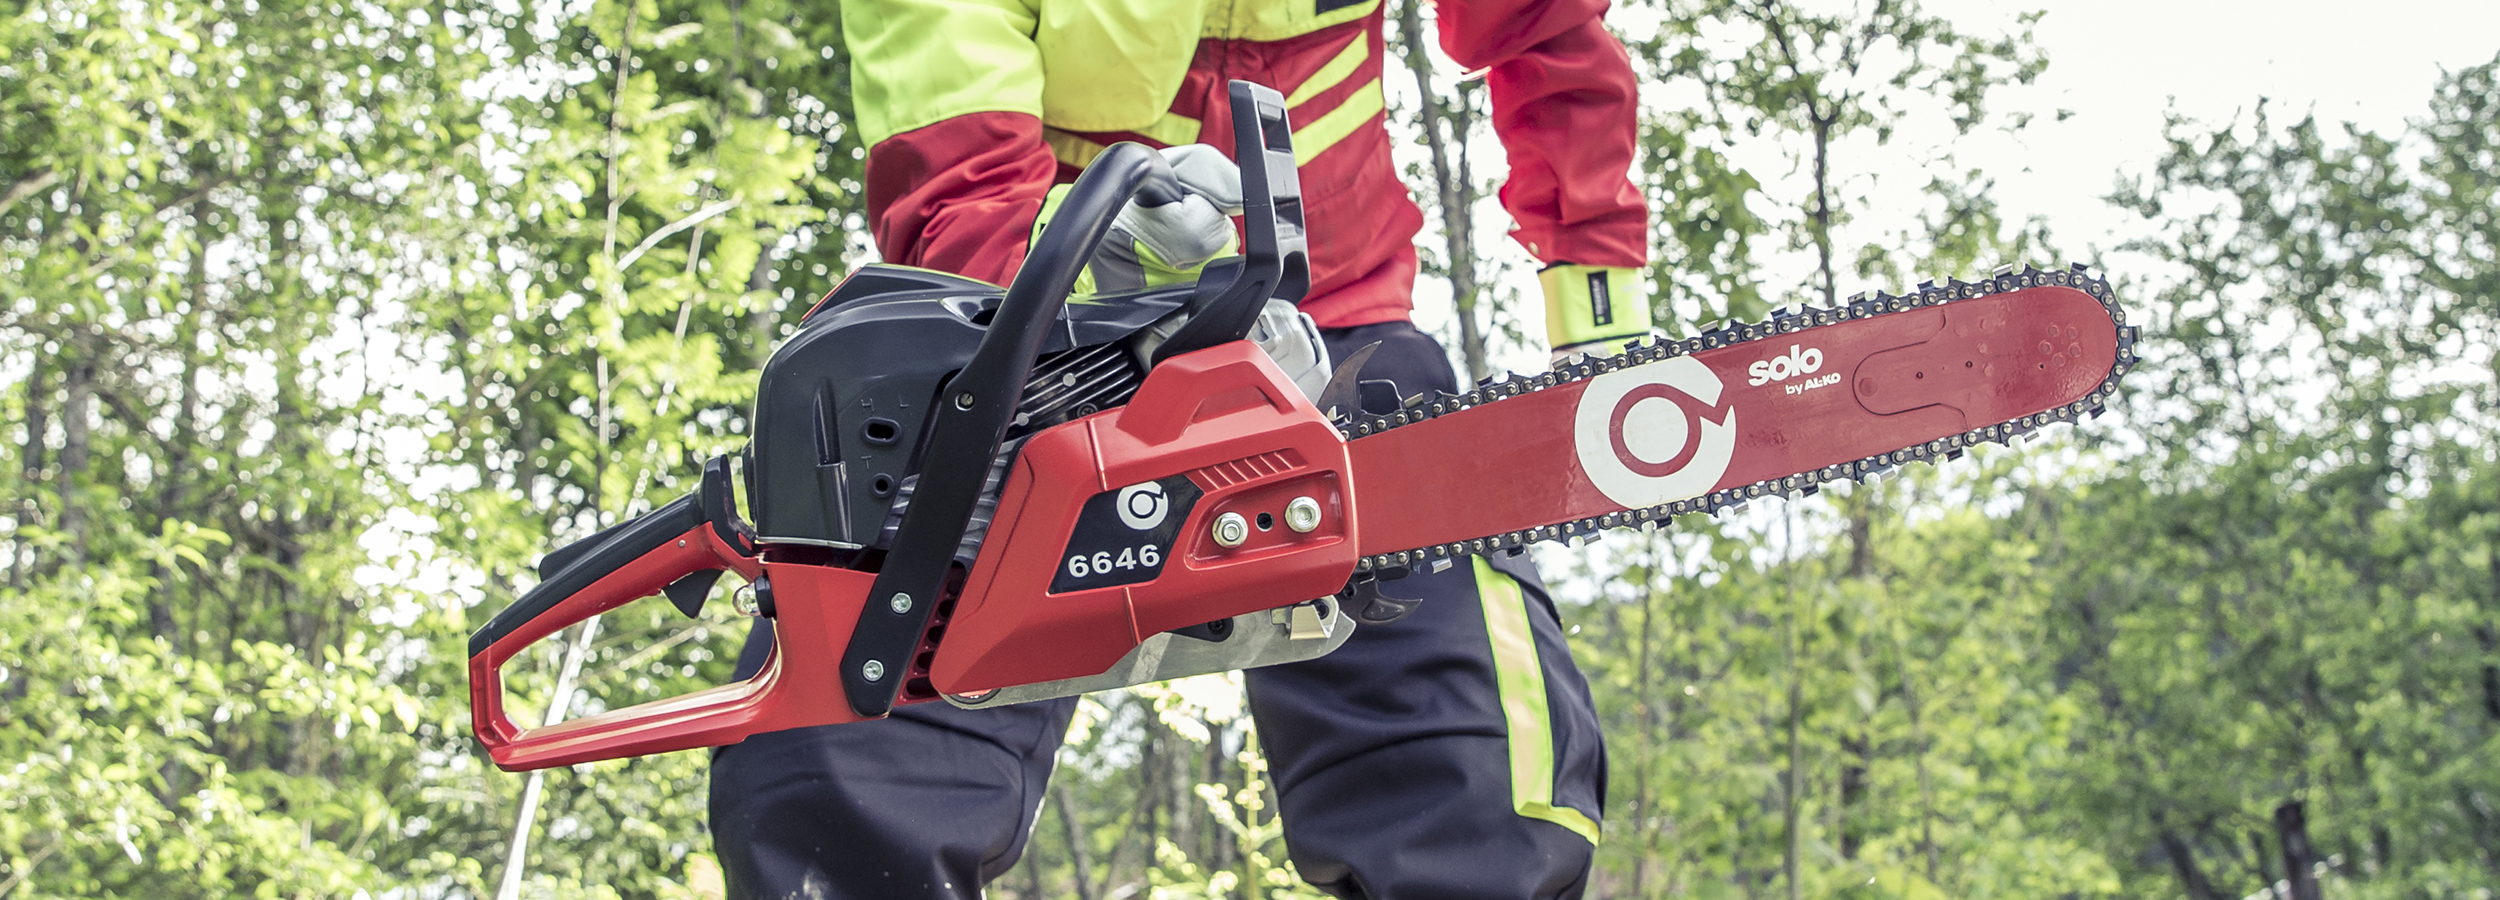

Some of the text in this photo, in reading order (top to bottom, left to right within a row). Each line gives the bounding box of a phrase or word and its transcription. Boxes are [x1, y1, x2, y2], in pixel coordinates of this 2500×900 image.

[1748, 344, 1824, 387] solo
[1785, 383, 1803, 396] by
[861, 398, 875, 414] H
[861, 455, 872, 470] T
[1068, 544, 1160, 578] 6646
